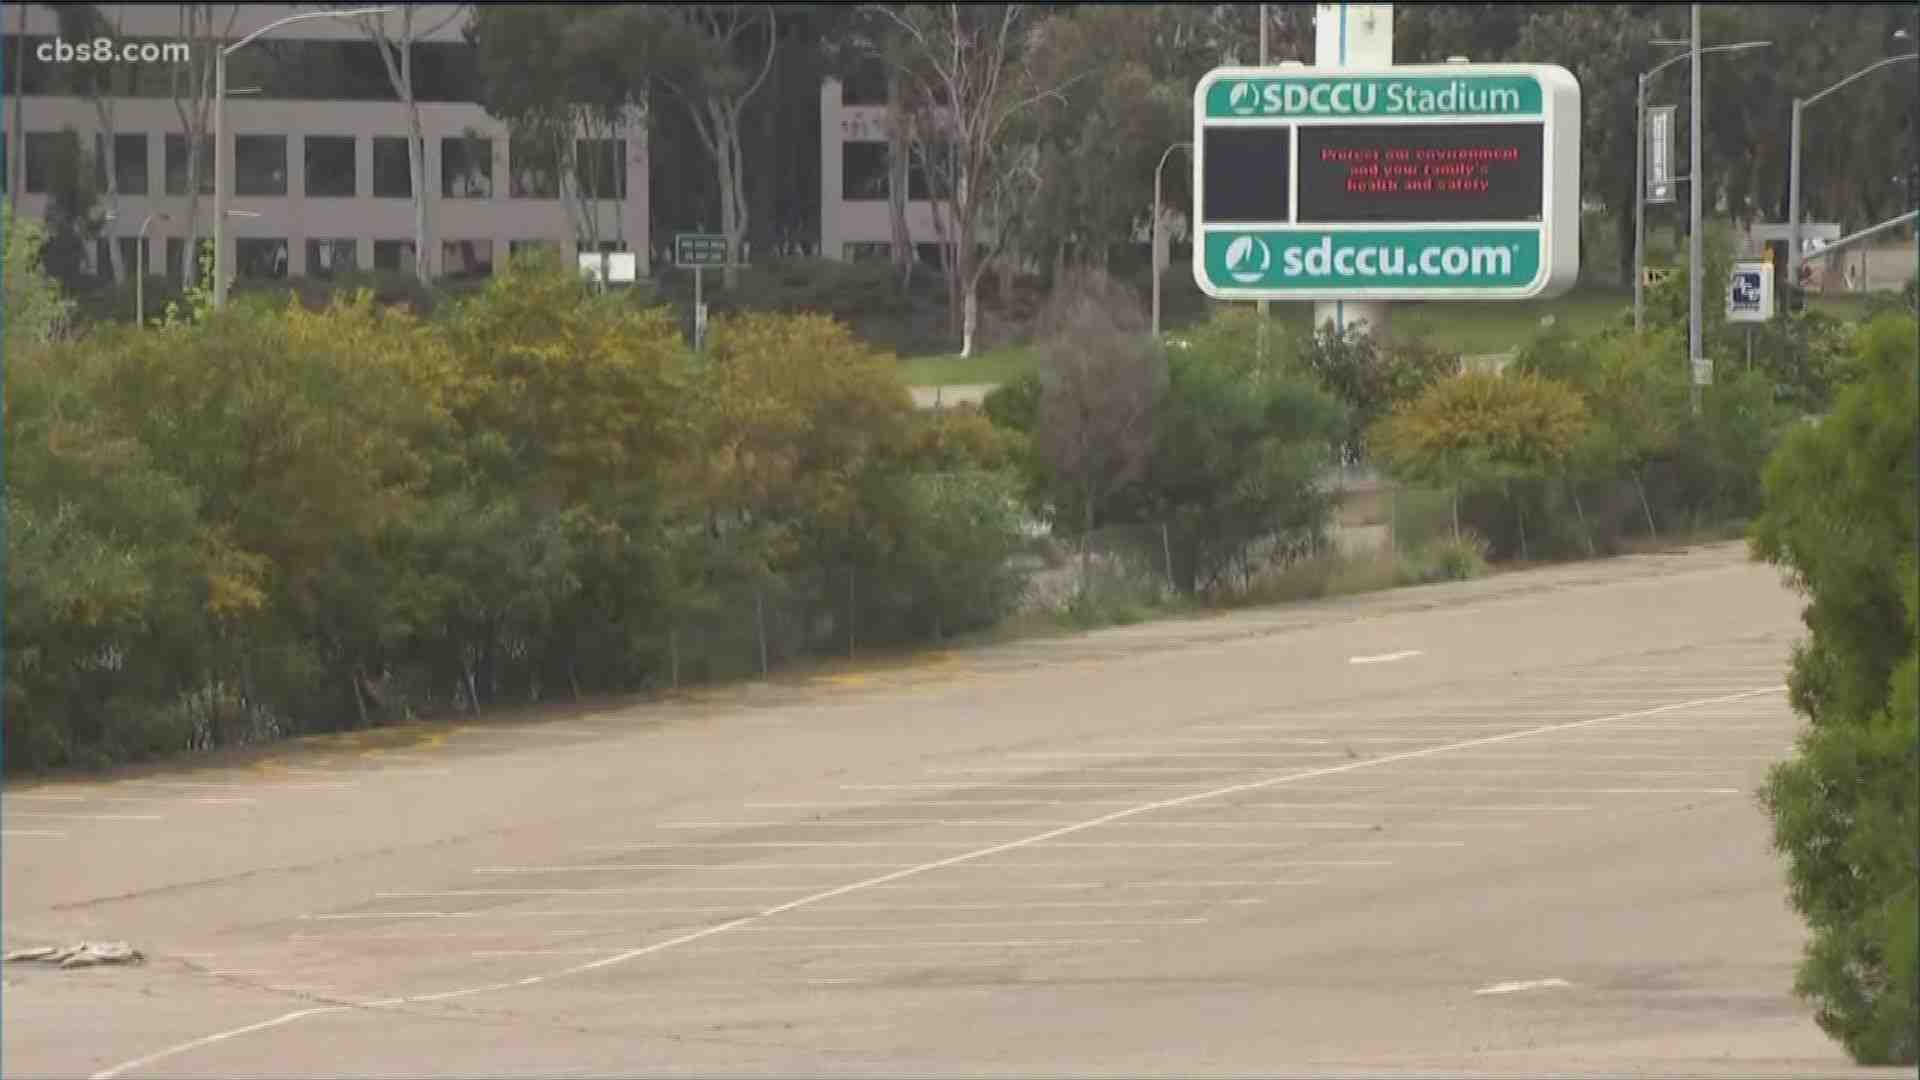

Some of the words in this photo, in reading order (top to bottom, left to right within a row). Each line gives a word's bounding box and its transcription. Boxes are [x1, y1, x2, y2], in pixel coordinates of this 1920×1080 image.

[1263, 83, 1376, 113] SDCCU
[1387, 81, 1519, 113] Stadium
[1321, 147, 1378, 160] Protect
[1417, 147, 1518, 160] environment
[1350, 164, 1378, 176] and
[1384, 165, 1417, 178] your
[1346, 178, 1397, 191] health
[1405, 178, 1432, 191] and
[1283, 236, 1512, 276] sdccu.com
